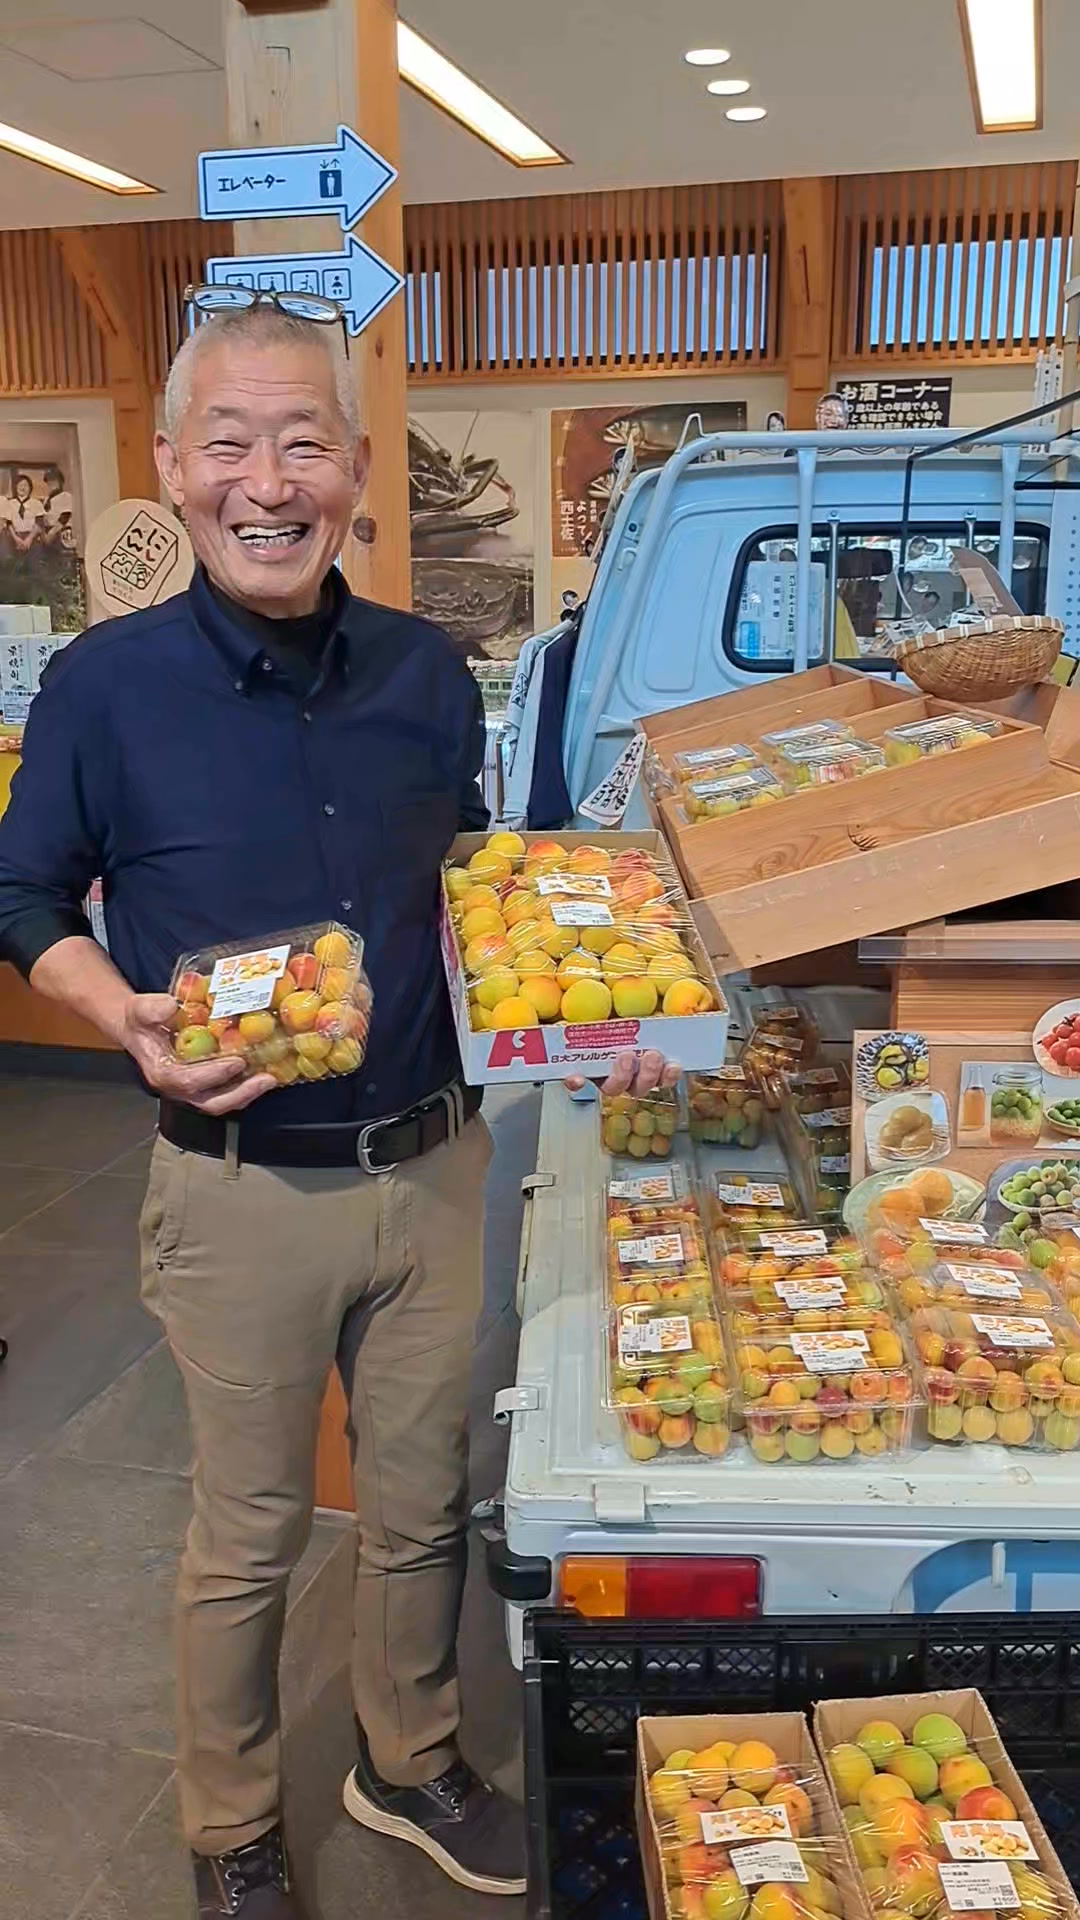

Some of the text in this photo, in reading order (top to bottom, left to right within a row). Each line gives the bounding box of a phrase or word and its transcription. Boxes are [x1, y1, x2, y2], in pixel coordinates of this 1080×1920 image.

[217, 174, 287, 192] エレベーター
[842, 381, 950, 401] お酒コーナー
[560, 500, 575, 541] 西土佐
